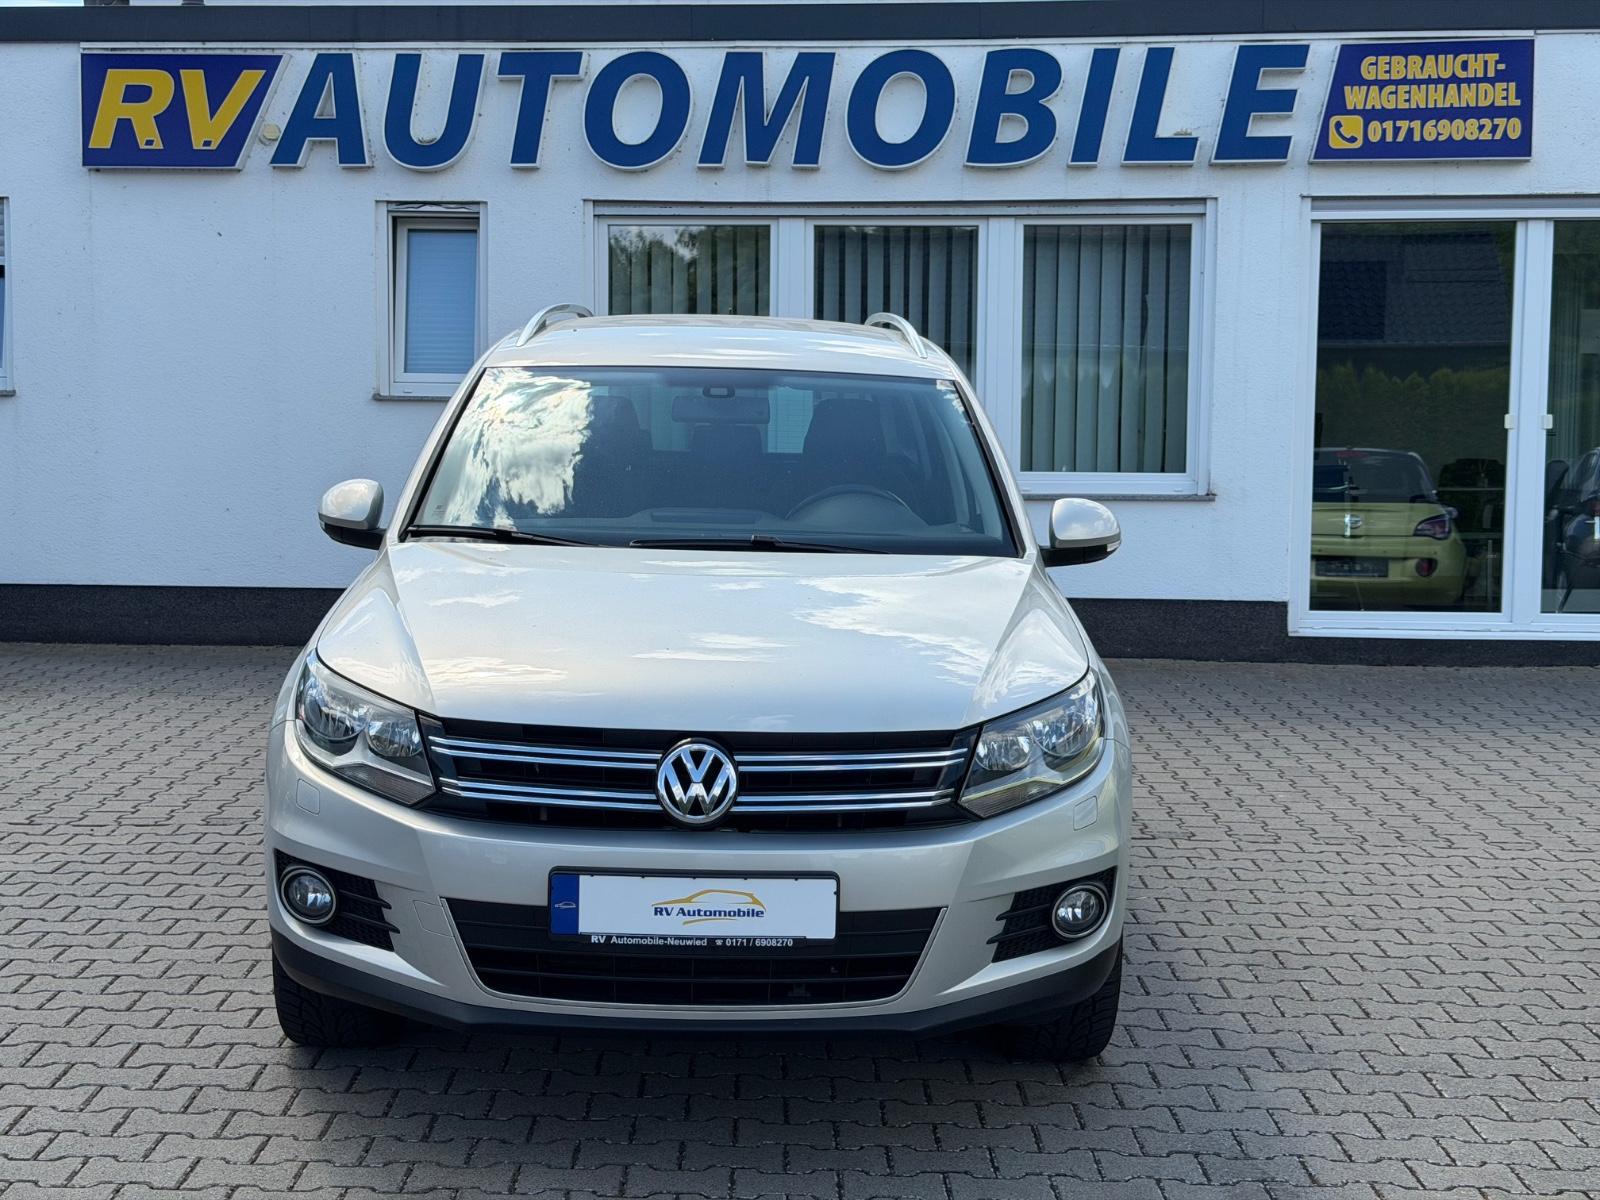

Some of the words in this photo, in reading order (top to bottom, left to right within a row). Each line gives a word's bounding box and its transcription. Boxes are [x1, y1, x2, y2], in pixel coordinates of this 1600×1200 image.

[1360, 53, 1506, 80] GEBRAUCHT-
[270, 45, 1310, 170] AUTOMOBILE
[1344, 82, 1521, 110] WAGENHANDEL
[1367, 118, 1521, 143] 01716908270
[654, 906, 674, 917] RV
[676, 907, 765, 918] Automobile
[591, 935, 606, 944] RV
[611, 936, 708, 946] Automobile-Neuwied
[726, 938, 747, 948] 0171
[755, 938, 793, 948] 6908270
